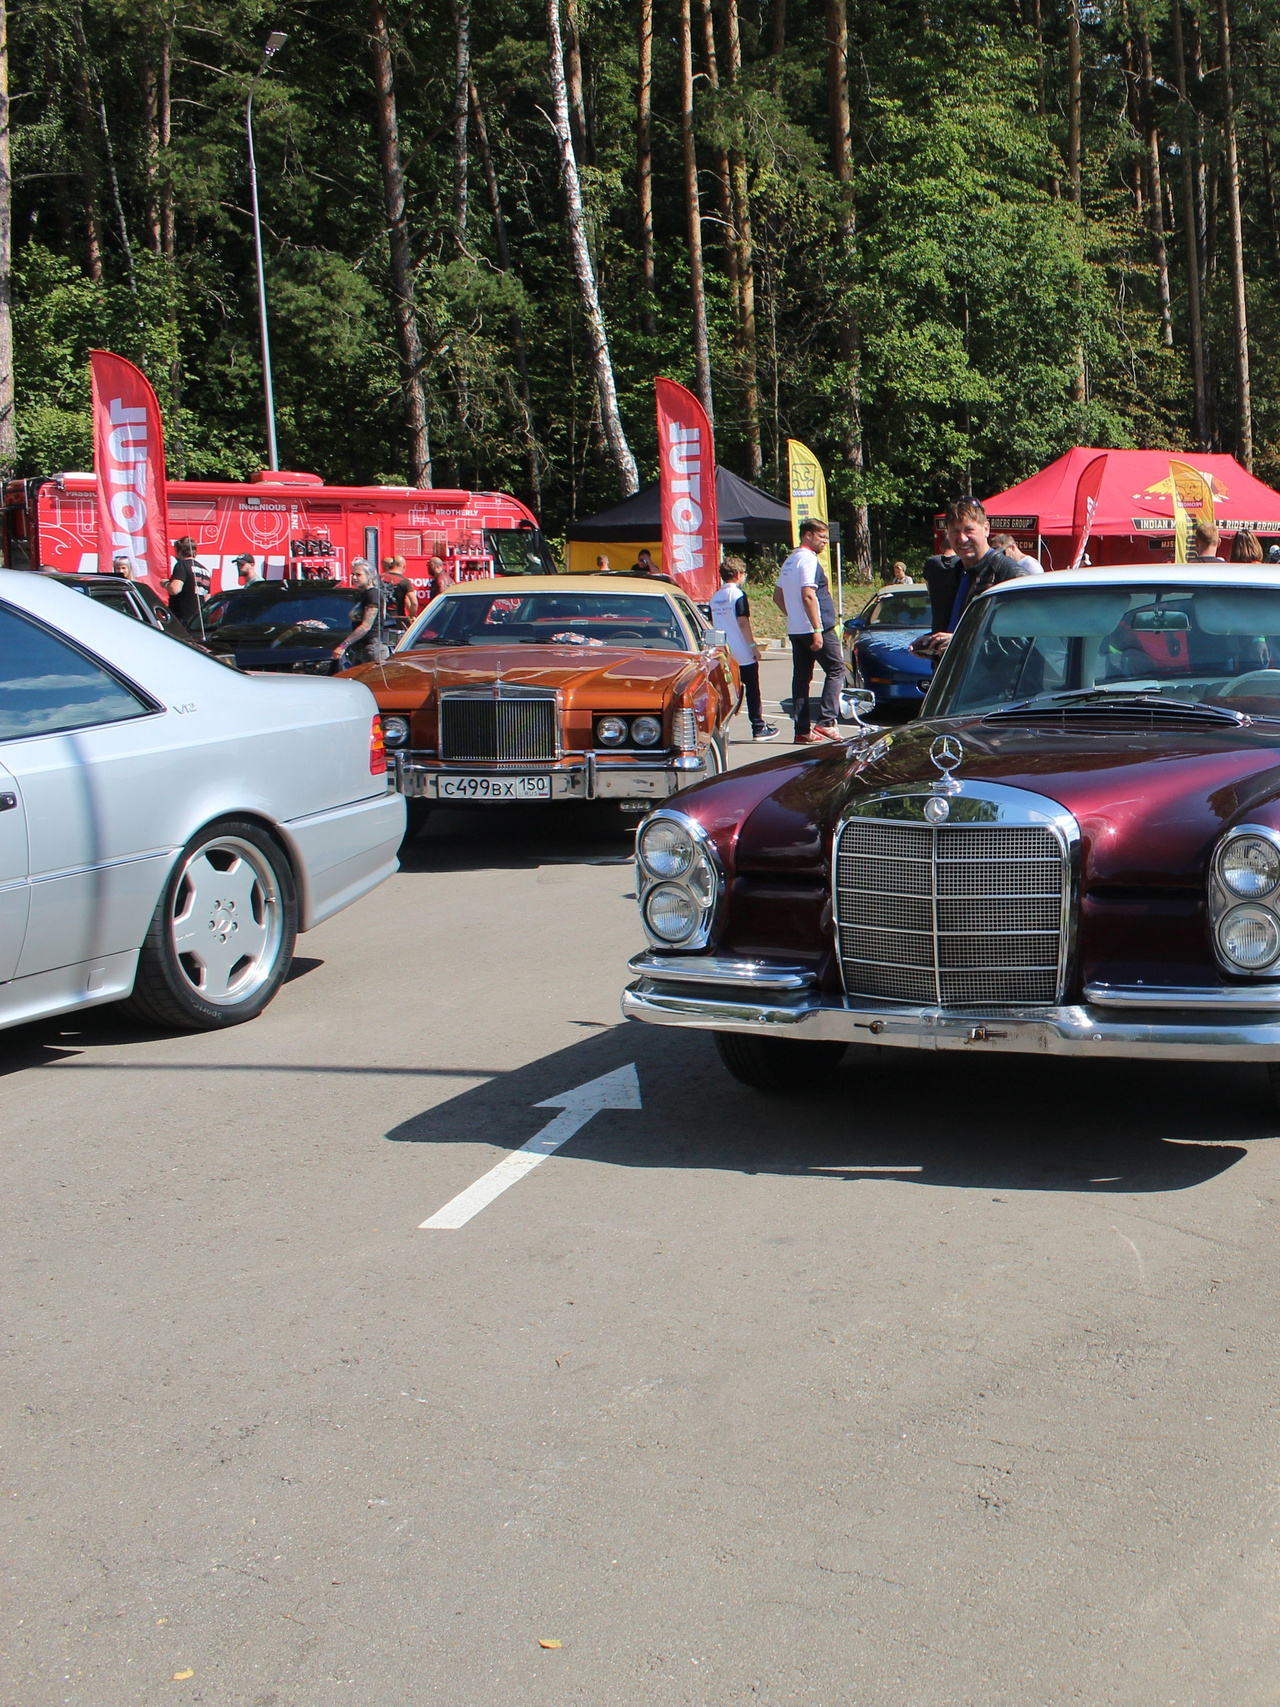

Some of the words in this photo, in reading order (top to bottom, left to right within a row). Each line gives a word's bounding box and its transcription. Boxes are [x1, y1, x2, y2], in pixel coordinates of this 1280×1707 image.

[238, 503, 286, 511] INGENIOUS
[991, 518, 1011, 528] RIDERS
[1140, 520, 1171, 530] INDIAN
[1225, 521, 1254, 531] RIDERS
[519, 777, 545, 791] 150
